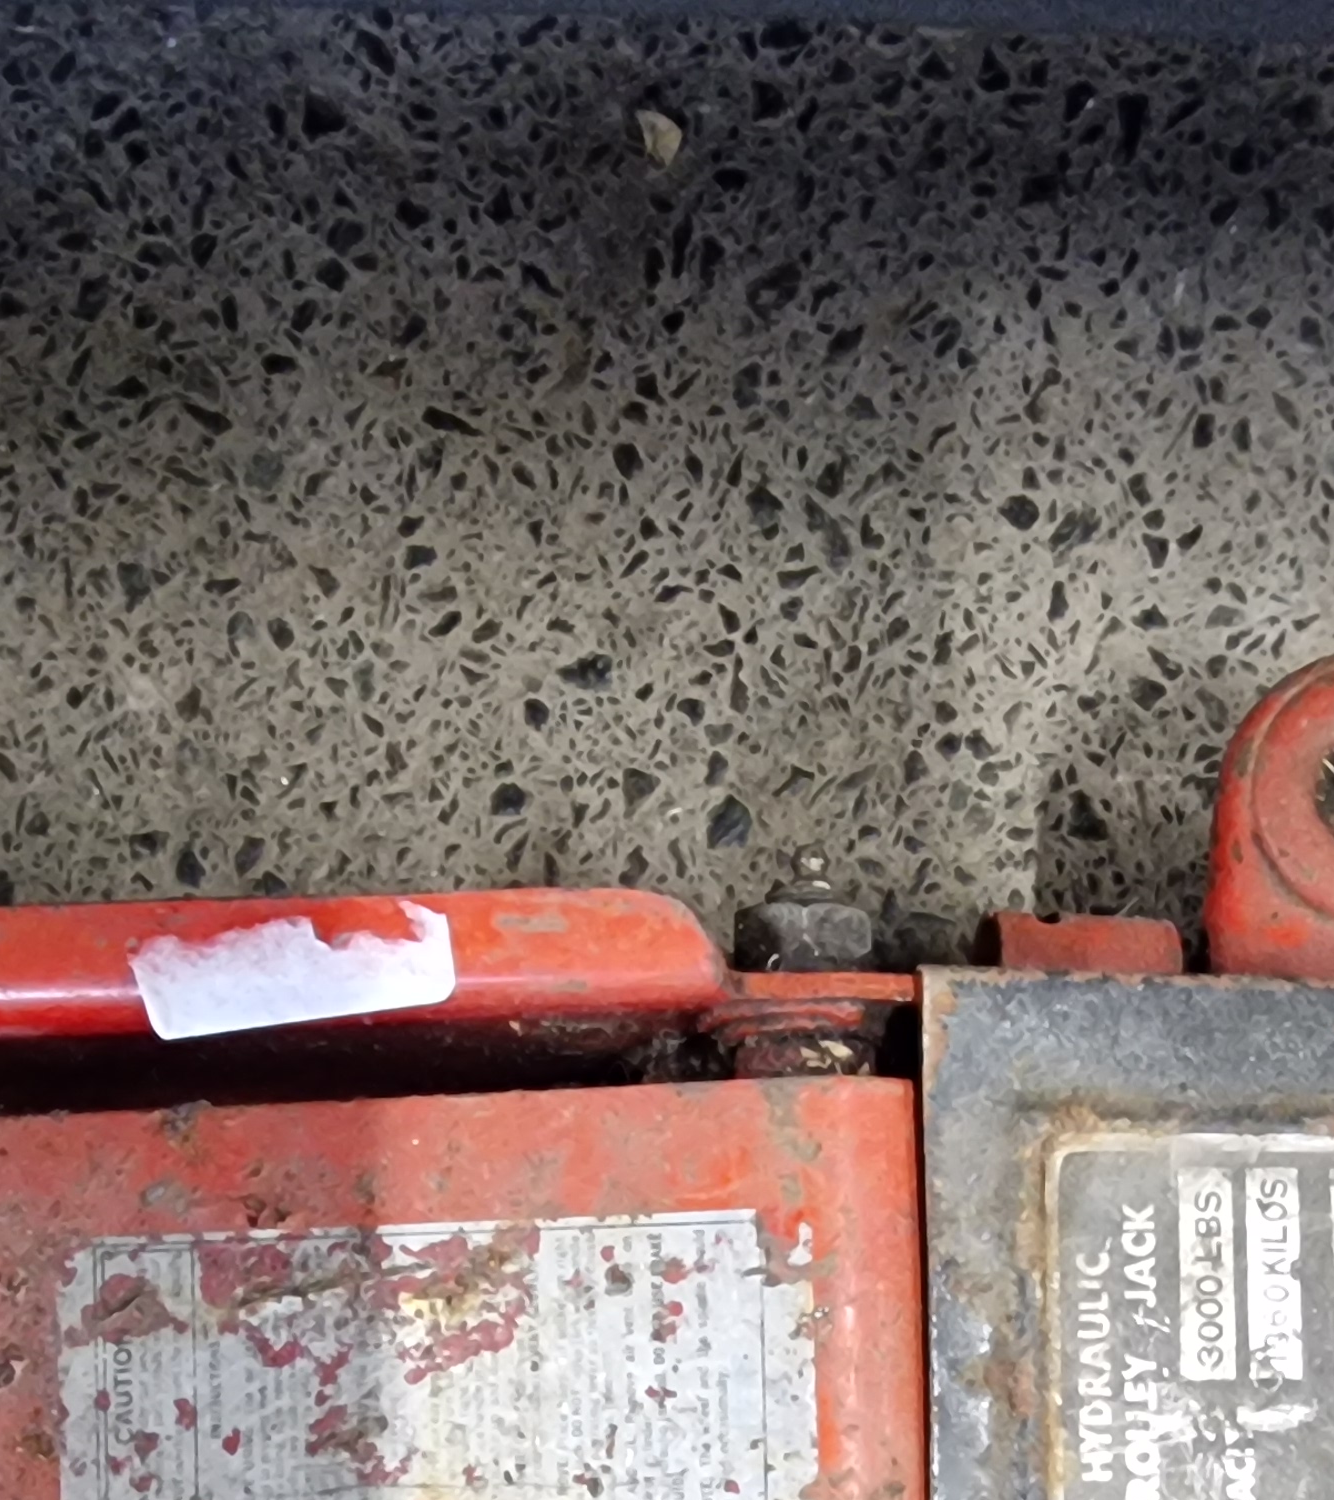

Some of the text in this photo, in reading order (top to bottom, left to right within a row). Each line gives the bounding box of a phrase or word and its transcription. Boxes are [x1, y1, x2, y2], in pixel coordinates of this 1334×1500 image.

[1122, 1203, 1157, 1308] JACK
[1259, 1178, 1289, 1276] KILOS
[1077, 1251, 1112, 1482] HYDRAULIC
[1195, 1275, 1223, 1371] 3000
